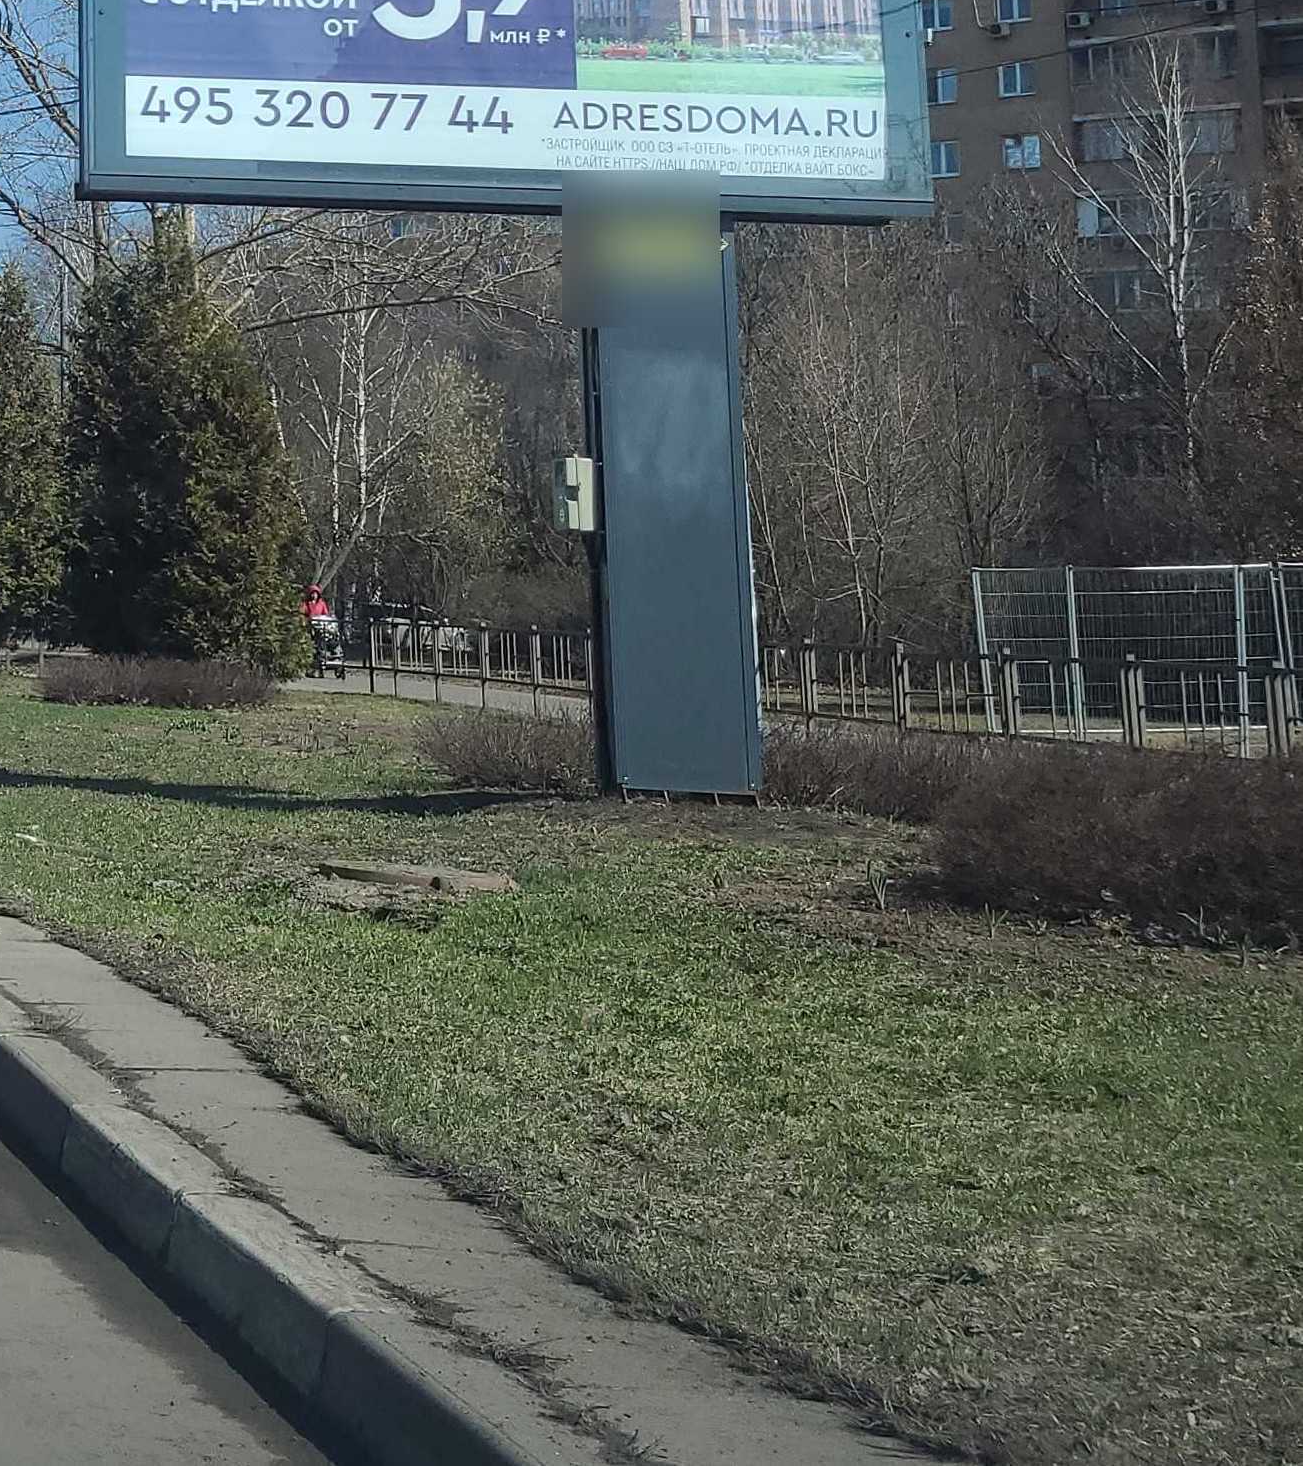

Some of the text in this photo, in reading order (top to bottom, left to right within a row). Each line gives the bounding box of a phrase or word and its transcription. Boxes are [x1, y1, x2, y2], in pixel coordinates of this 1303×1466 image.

[323, 18, 359, 37] ОТ
[140, 85, 514, 134] 495 320 77 44
[553, 101, 879, 138] ADRESDOMA.RU
[631, 140, 655, 153] ООО
[745, 143, 810, 158] ПРОЕКТНАЯ
